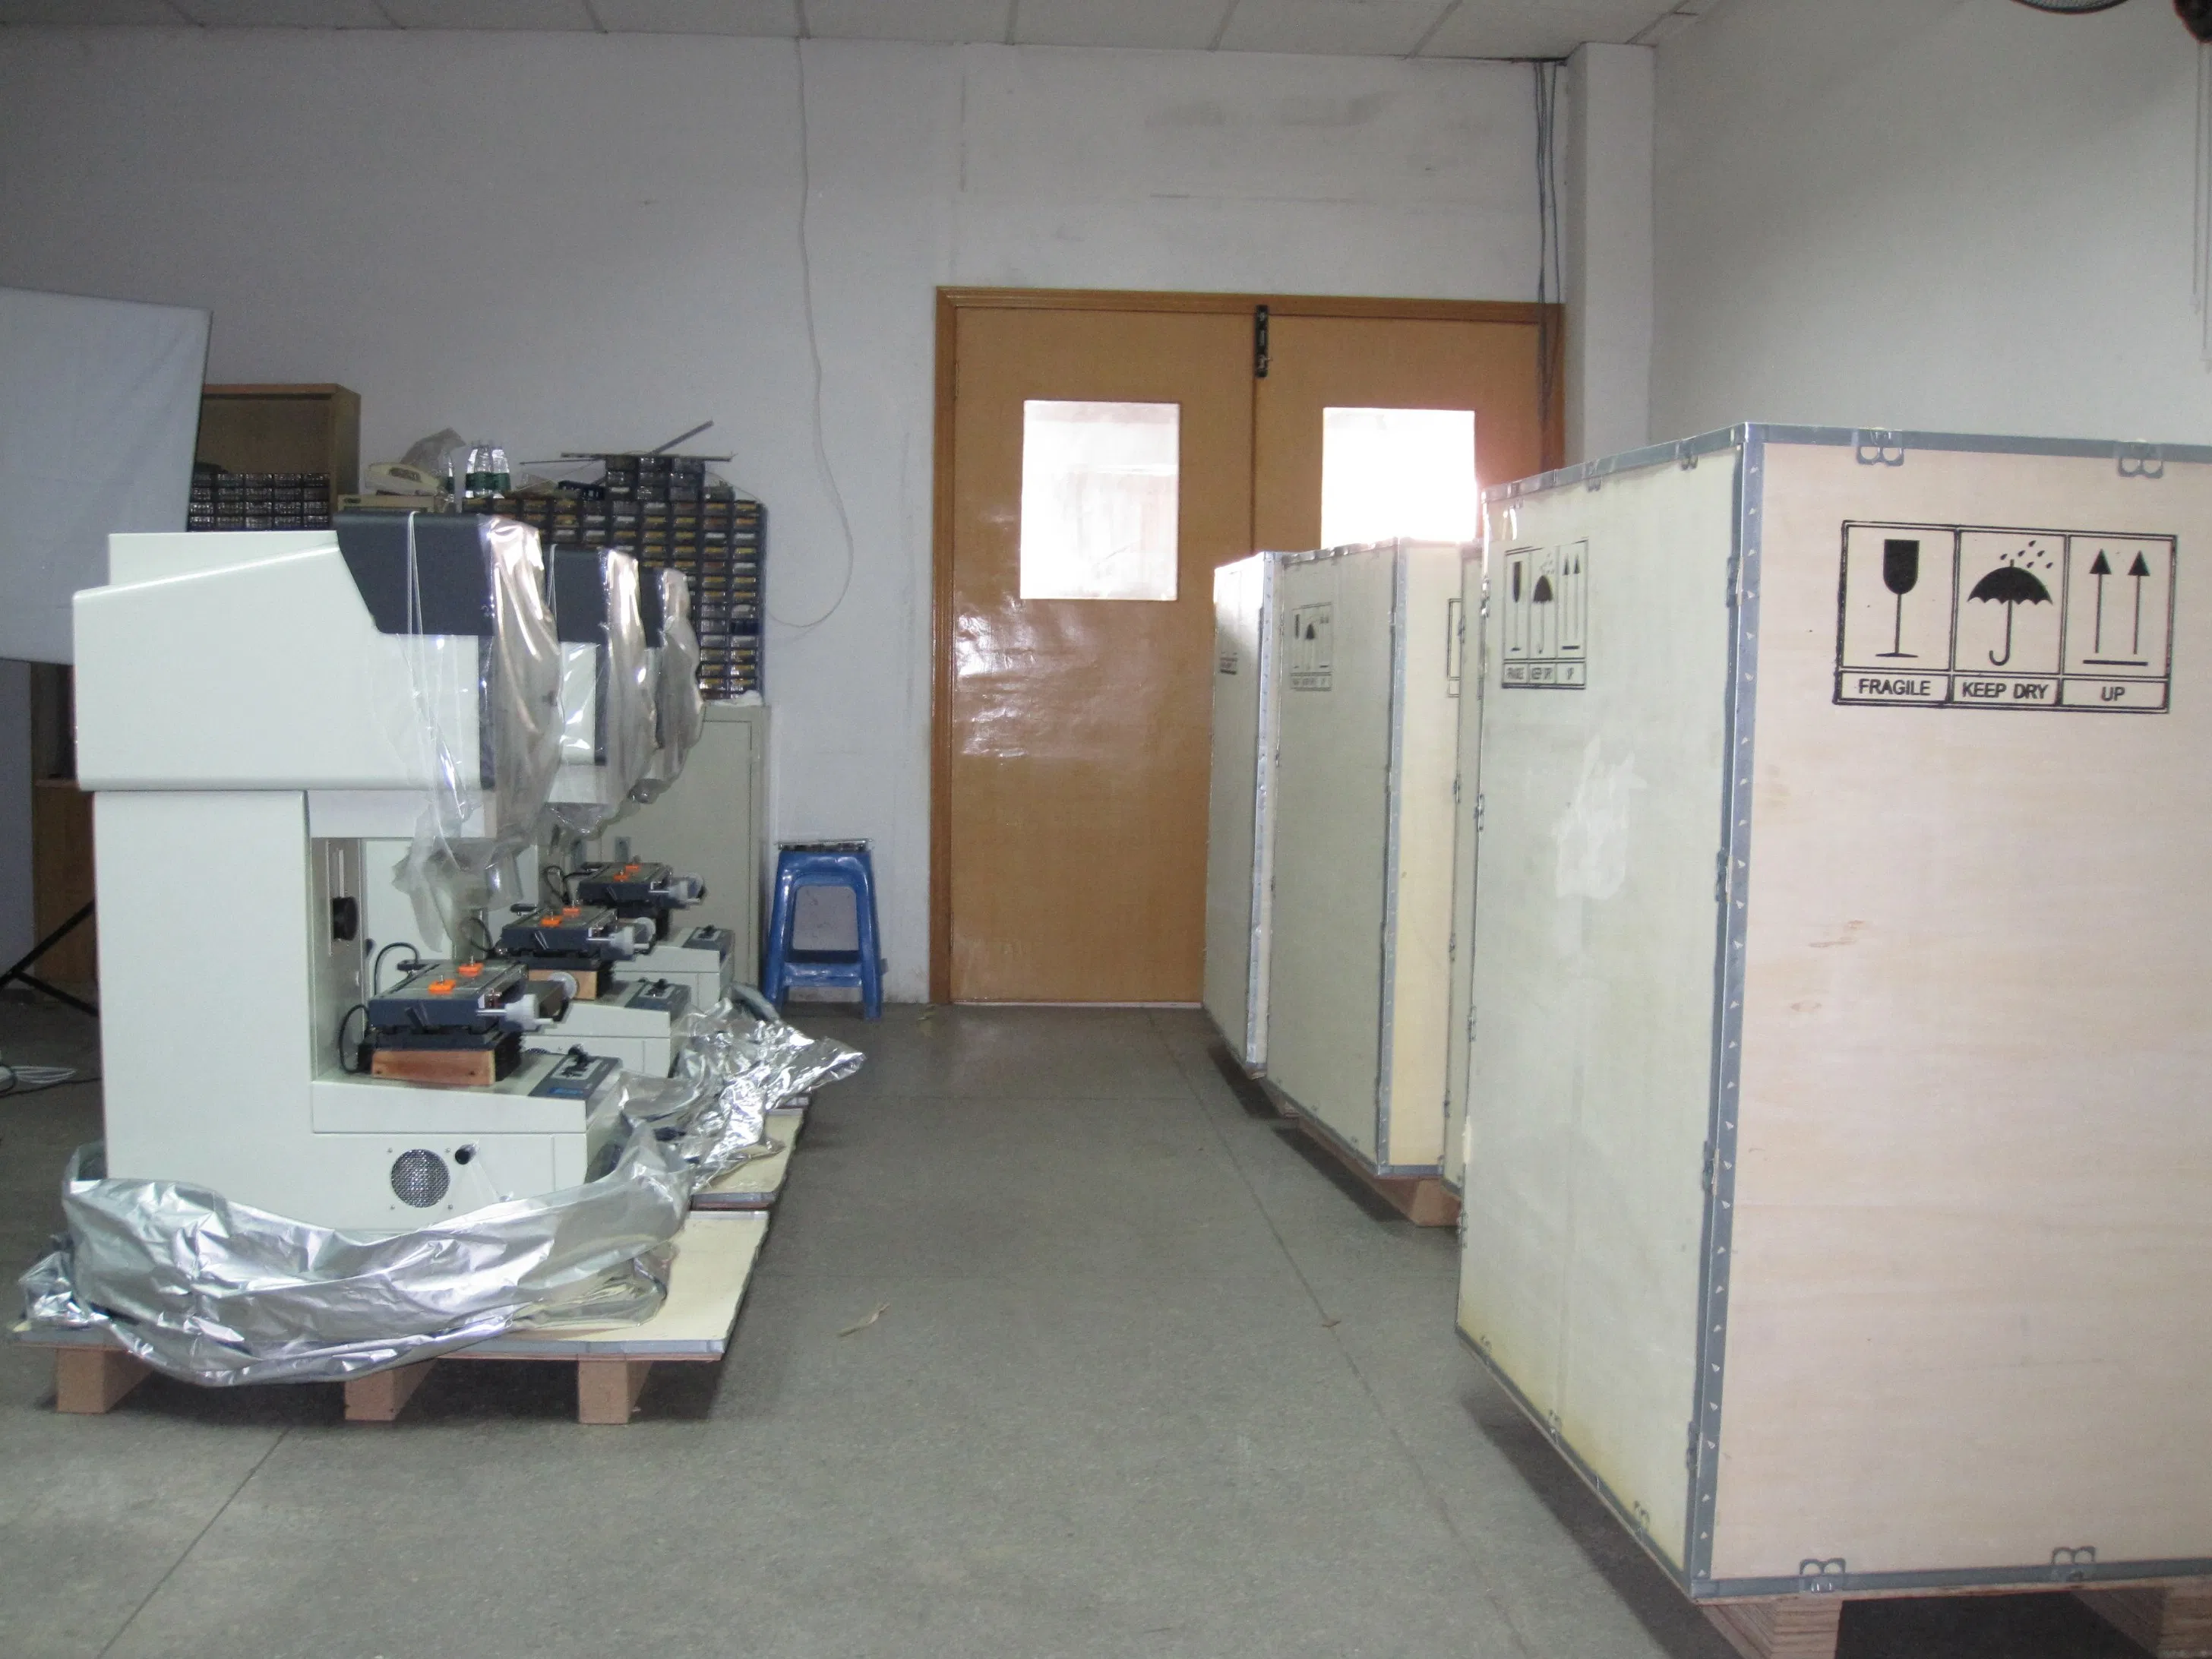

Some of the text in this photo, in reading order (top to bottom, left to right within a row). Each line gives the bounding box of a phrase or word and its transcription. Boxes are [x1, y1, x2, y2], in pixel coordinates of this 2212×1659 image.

[1857, 678, 1932, 696] FRAGILE
[1962, 681, 2049, 700] KEEP DRY
[2101, 686, 2125, 701] UP
